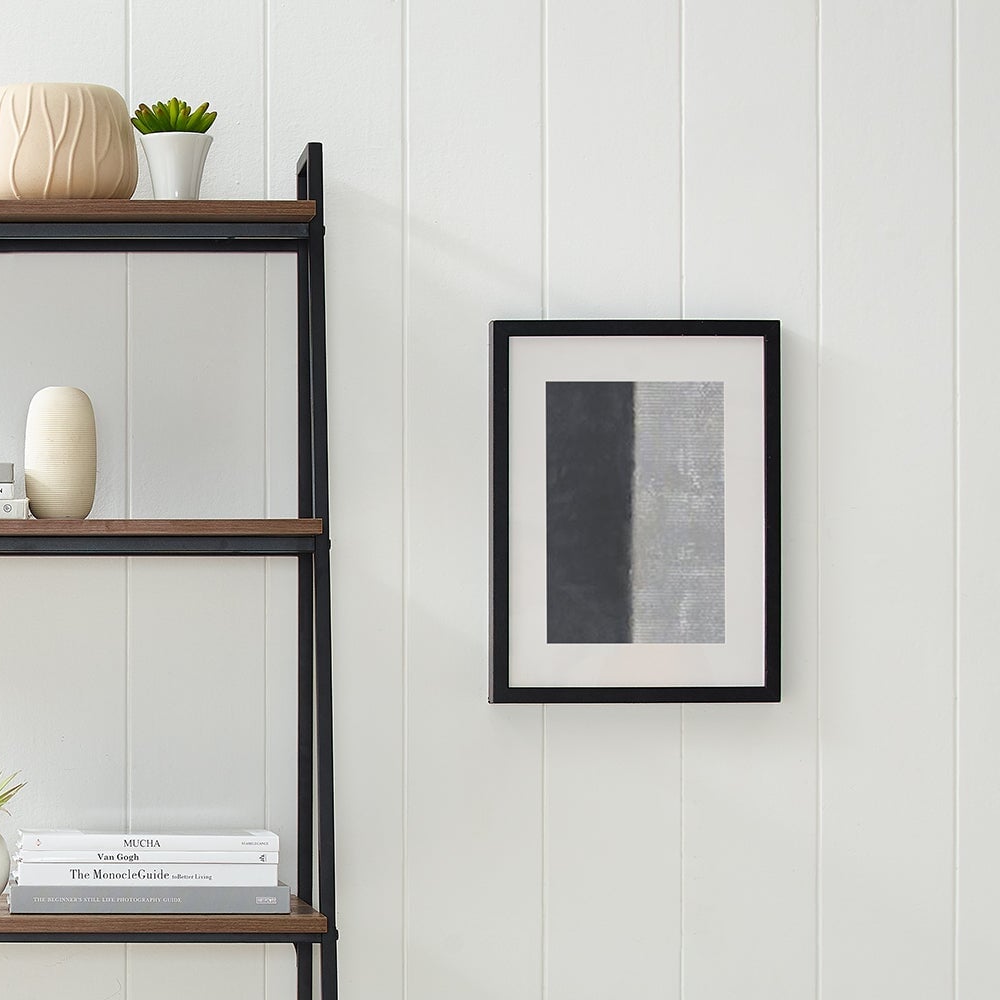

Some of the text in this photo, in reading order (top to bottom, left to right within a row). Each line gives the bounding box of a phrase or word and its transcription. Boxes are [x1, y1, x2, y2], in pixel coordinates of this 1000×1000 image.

[123, 839, 161, 848] MUCHA
[97, 853, 140, 862] Van Gogh
[70, 869, 90, 880] The
